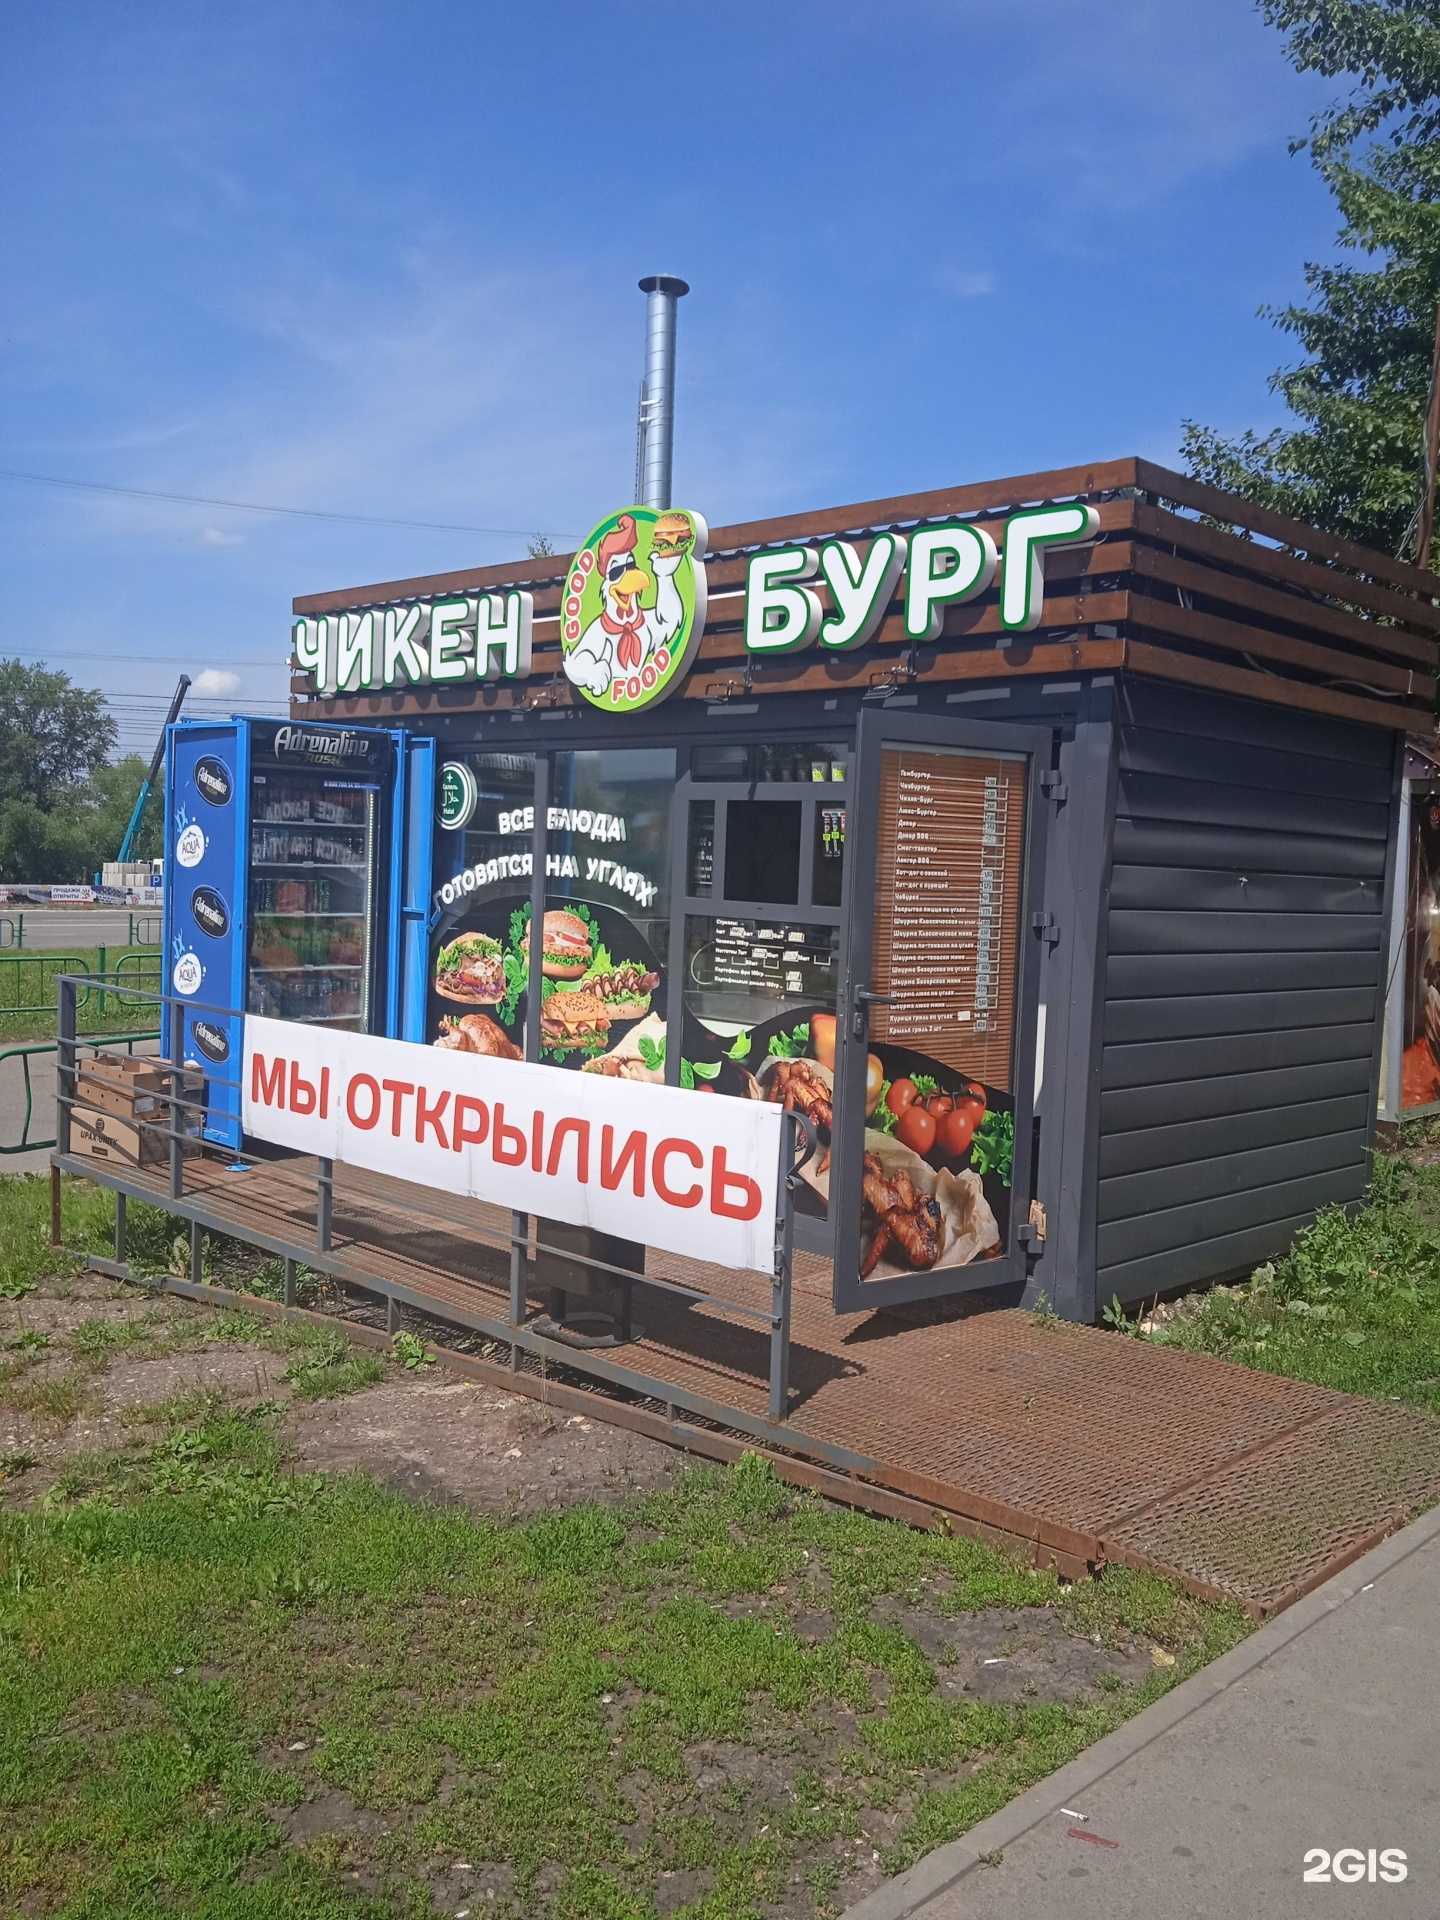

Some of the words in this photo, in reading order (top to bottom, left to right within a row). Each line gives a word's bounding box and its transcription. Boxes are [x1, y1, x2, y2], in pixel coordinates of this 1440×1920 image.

[296, 590, 529, 693] ЧИКЕН
[745, 502, 1096, 653] БУРГ
[565, 550, 594, 640] GOOD
[612, 647, 671, 702] FOOD
[274, 726, 368, 761] Adrenaline
[182, 838, 200, 855] AQUA
[498, 806, 534, 835] ВСЕ
[545, 854, 576, 878] НА
[586, 857, 655, 907] УГЛЯХ
[178, 966, 197, 982] AQUA
[251, 1053, 329, 1119] МЫ
[346, 1073, 762, 1221] ОТКРЫЛИСЬ
